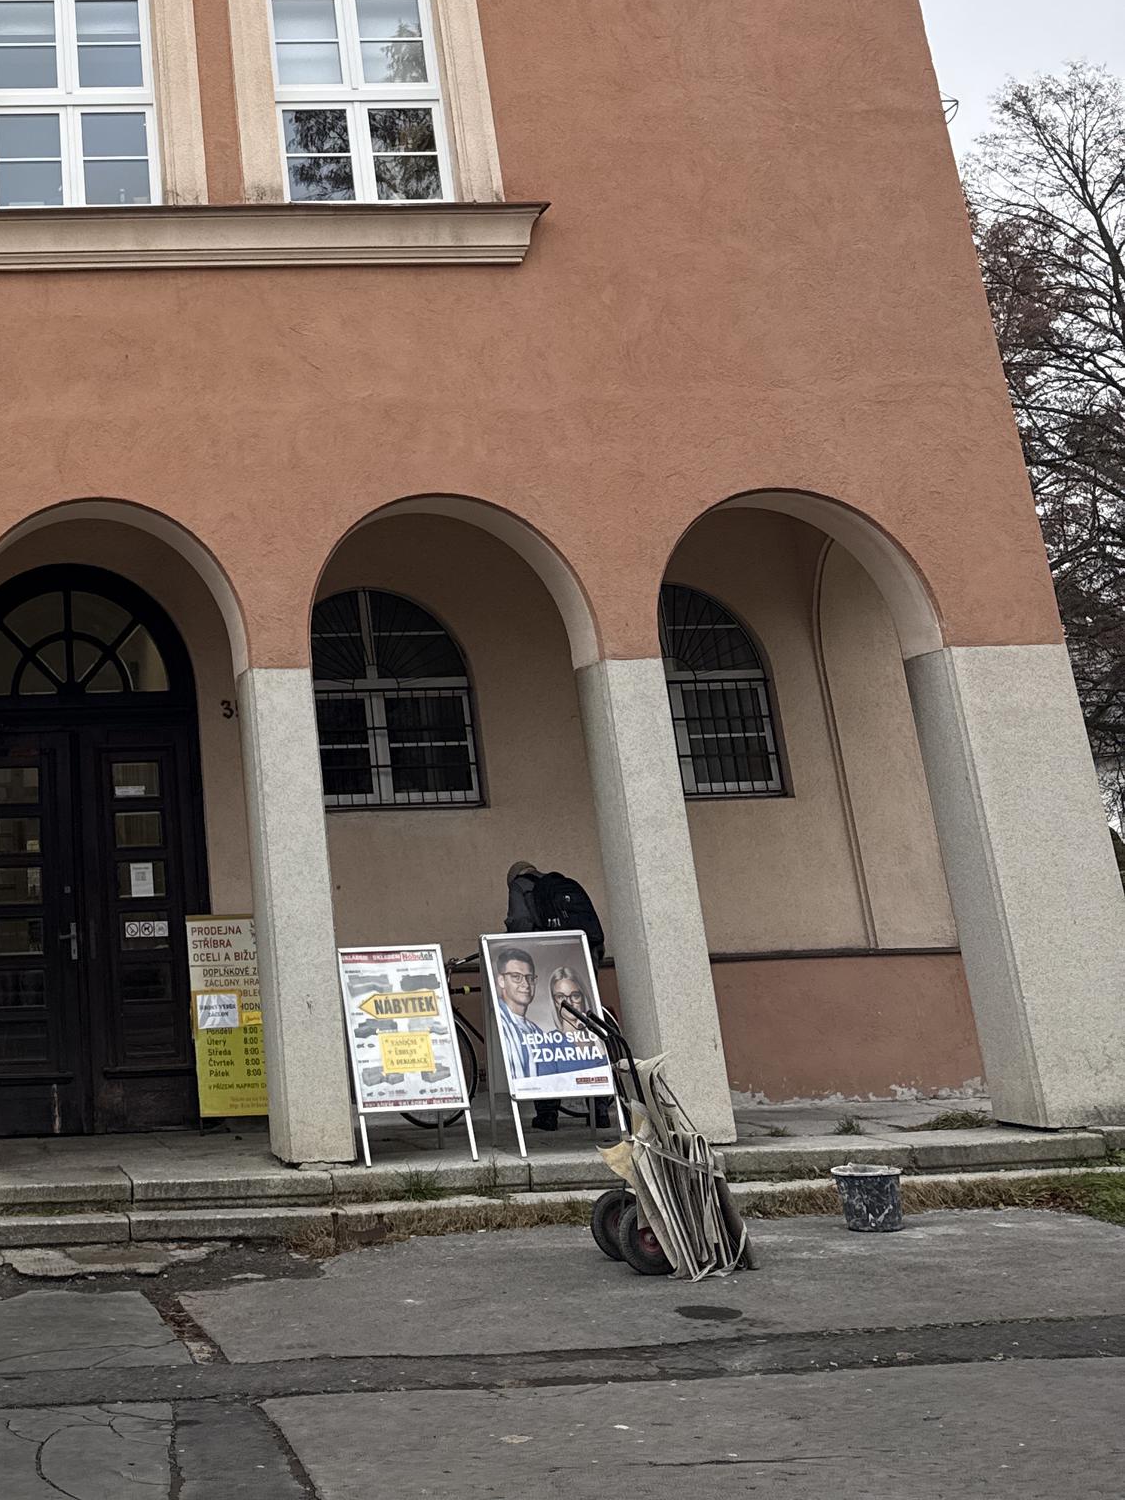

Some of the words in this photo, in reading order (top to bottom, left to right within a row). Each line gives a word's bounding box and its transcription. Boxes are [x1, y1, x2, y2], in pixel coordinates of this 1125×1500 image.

[191, 926, 242, 936] PRODEJNA
[192, 937, 232, 949] STŘÍBRA
[193, 952, 220, 962] OCELI
[224, 953, 231, 962] A
[203, 966, 249, 977] DOPLŇKOVÉ
[204, 978, 239, 987] ZÁCLONY
[374, 996, 435, 1015] NÁBYTEK
[522, 1032, 563, 1045] JEDNO
[532, 1046, 603, 1063] ZDARMA
[209, 1068, 229, 1077] Pátek
